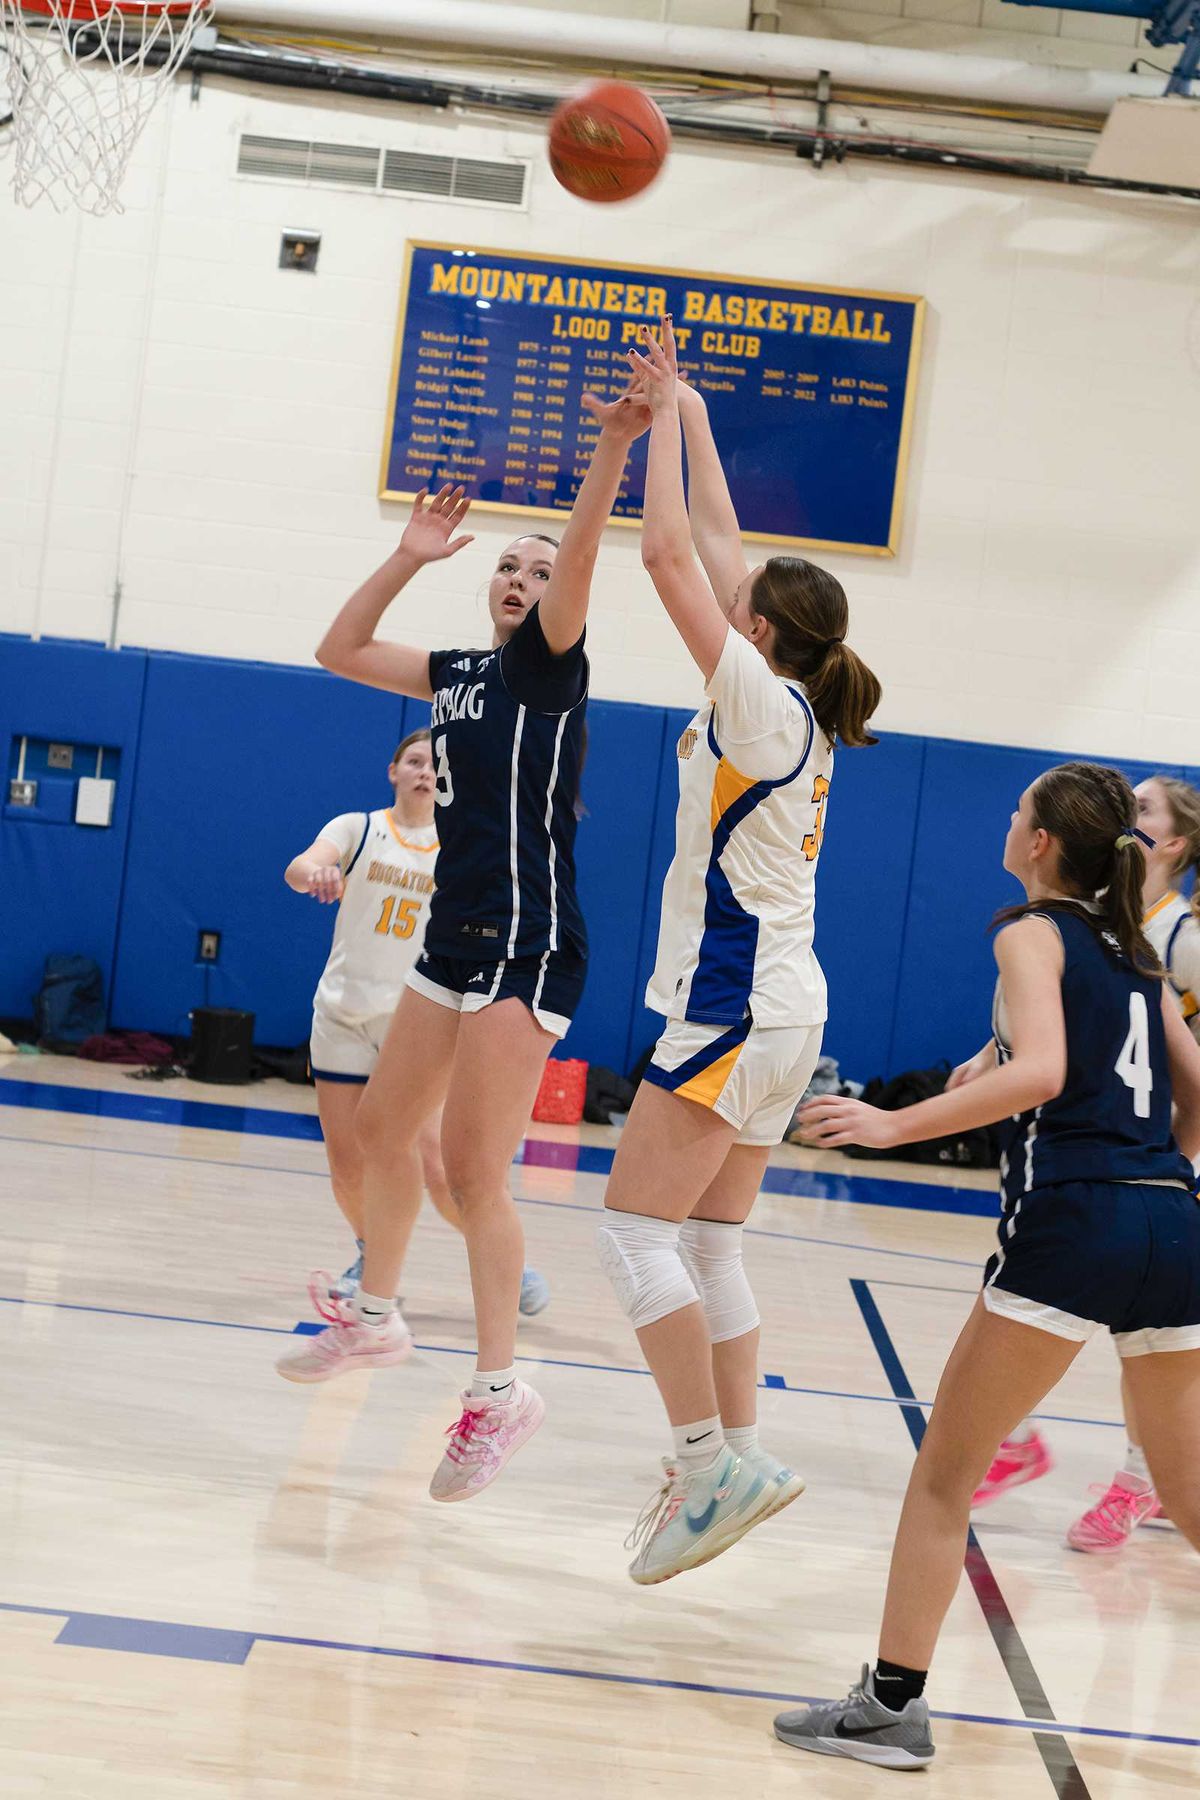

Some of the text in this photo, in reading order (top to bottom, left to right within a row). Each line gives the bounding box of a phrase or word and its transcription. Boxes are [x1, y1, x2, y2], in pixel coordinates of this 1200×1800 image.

[429, 263, 892, 343] MOUNTAINEER BASKETBALL
[421, 330, 459, 344] Michael
[552, 314, 611, 342] 1,000
[702, 330, 761, 358] CLUB
[859, 380, 888, 393] Points
[413, 397, 442, 410] James
[858, 396, 889, 408] Points
[441, 434, 475, 448] Martin
[452, 453, 486, 467] Martin
[374, 894, 422, 940] 15
[1113, 991, 1154, 1120] 4
